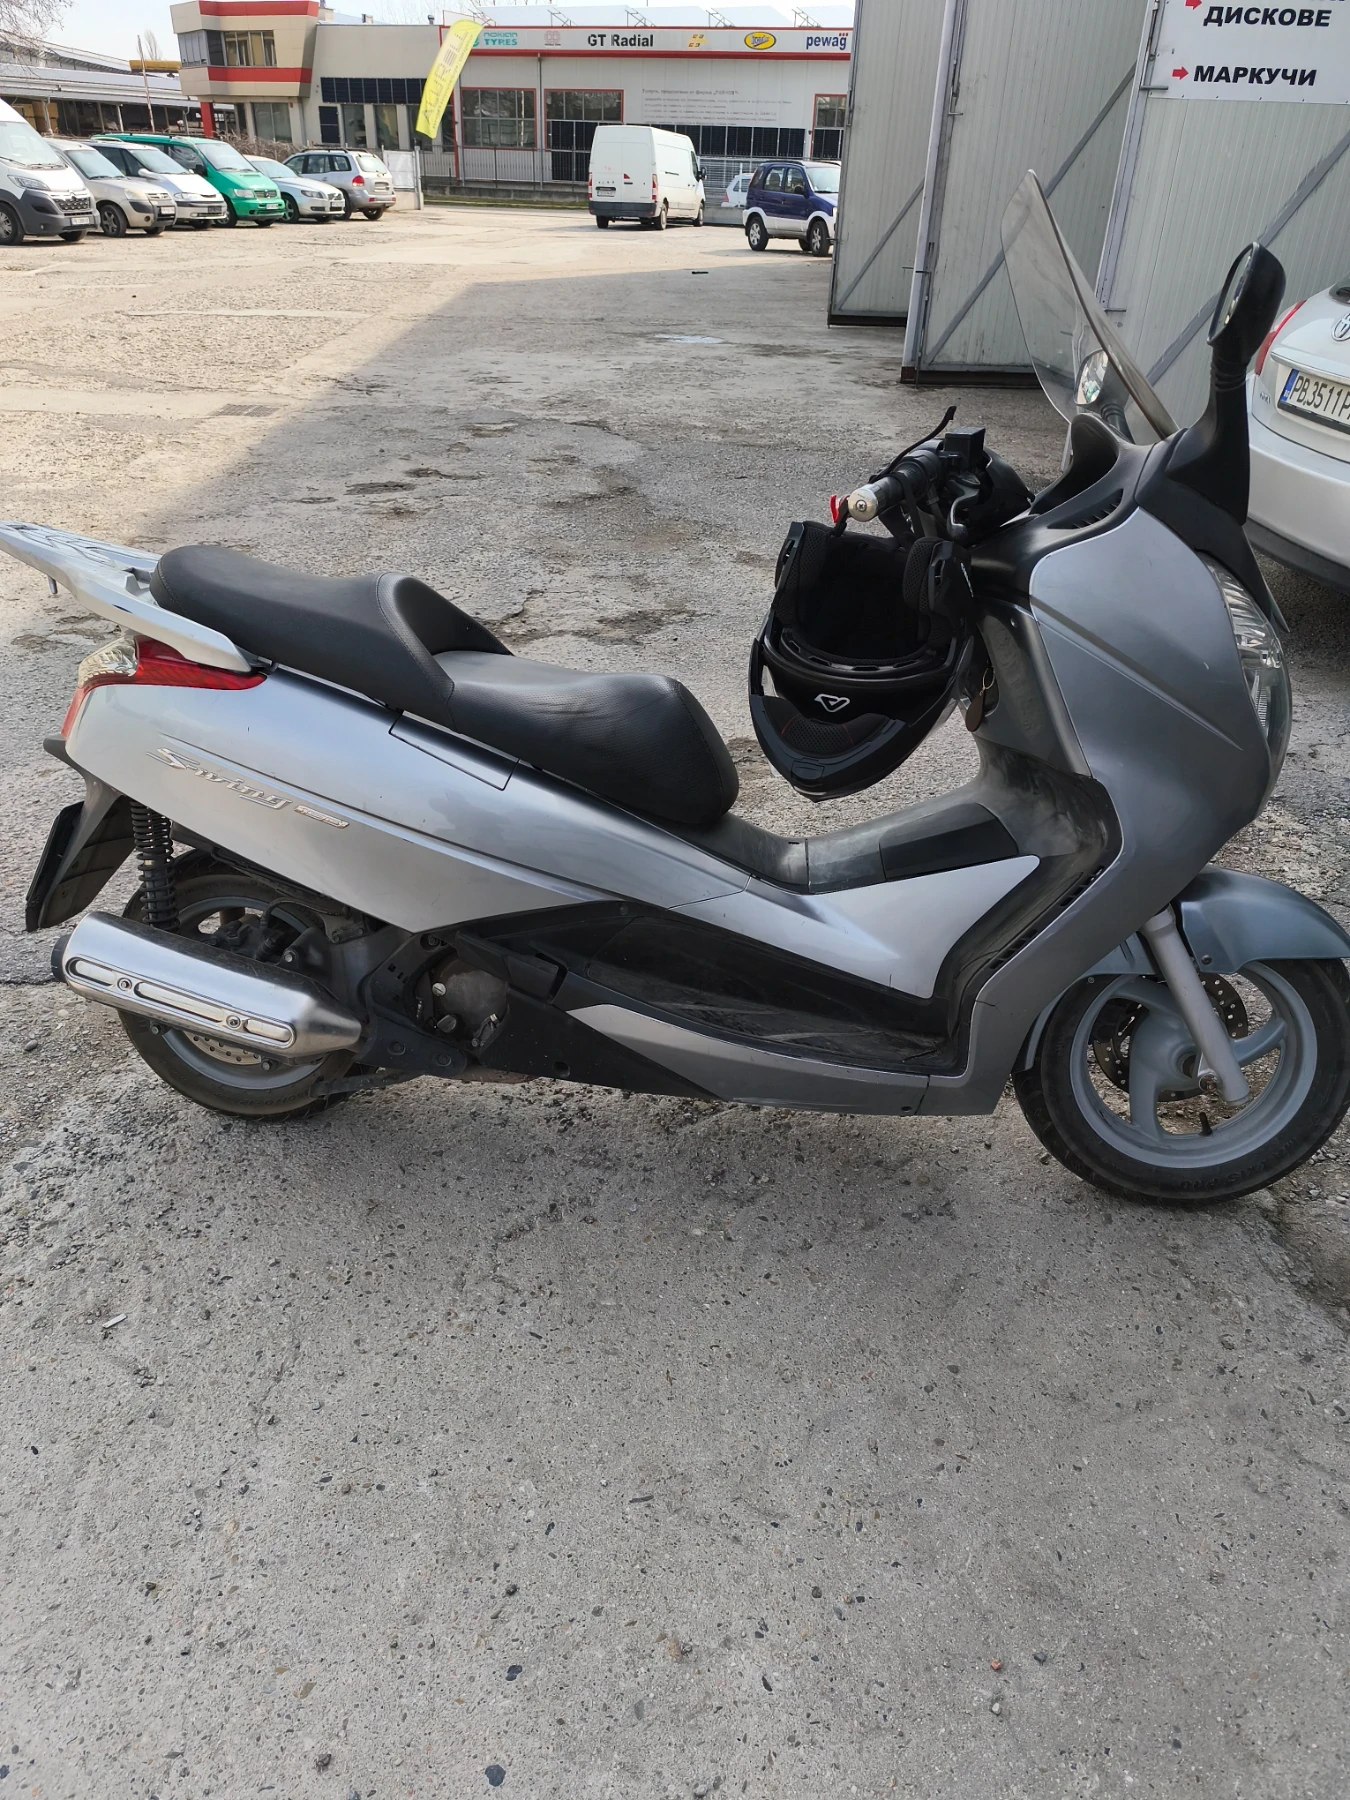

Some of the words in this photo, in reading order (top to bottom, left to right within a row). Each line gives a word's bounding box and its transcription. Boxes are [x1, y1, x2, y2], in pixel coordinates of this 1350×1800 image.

[1203, 6, 1333, 27] ДИСКОВЕ
[484, 38, 518, 46] TYRES
[588, 34, 606, 47] GT
[611, 34, 654, 47] Radial
[806, 34, 847, 50] pewag
[1193, 65, 1317, 86] МАРКУЧИ
[1289, 375, 1350, 420] PB3511P
